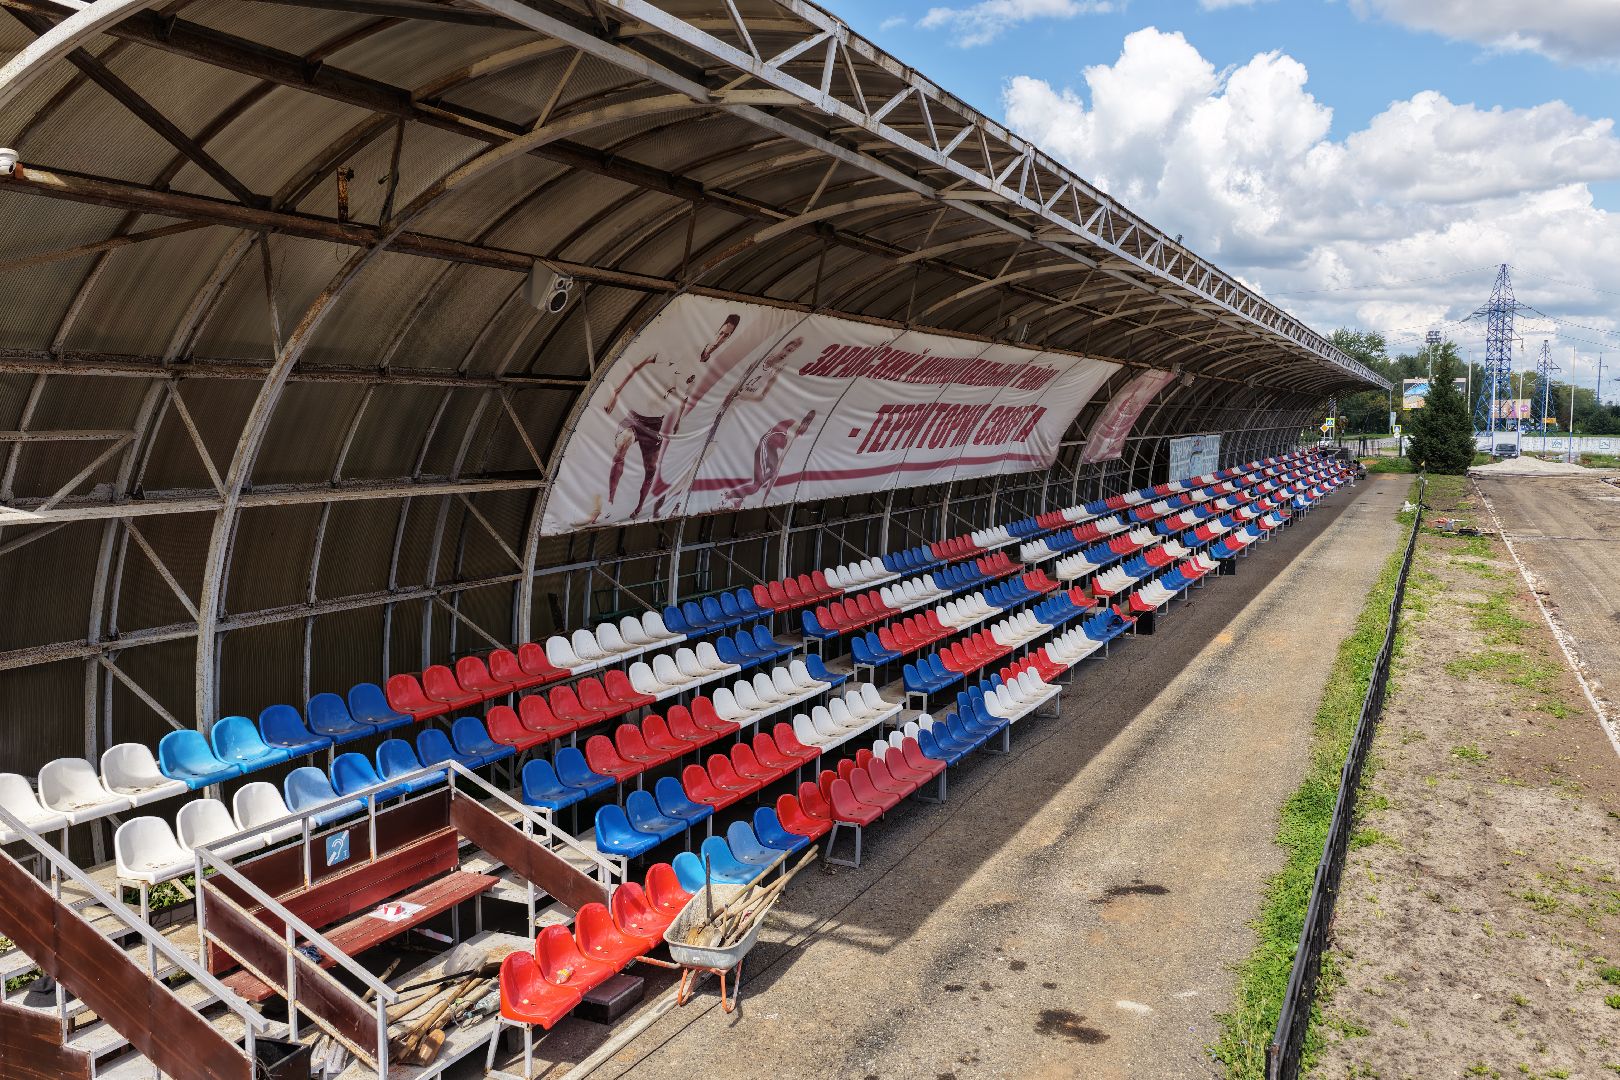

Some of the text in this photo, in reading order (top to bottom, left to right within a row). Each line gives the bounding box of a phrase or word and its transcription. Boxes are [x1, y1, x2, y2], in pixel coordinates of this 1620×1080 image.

[798, 340, 1060, 391] ЗАРАЙСКИЙ МУНИЦИПАЛЬНЫЙ РАЙОН
[857, 403, 992, 454] ТЕРРИТОРИЯ
[972, 403, 1047, 446] СПОРТА
